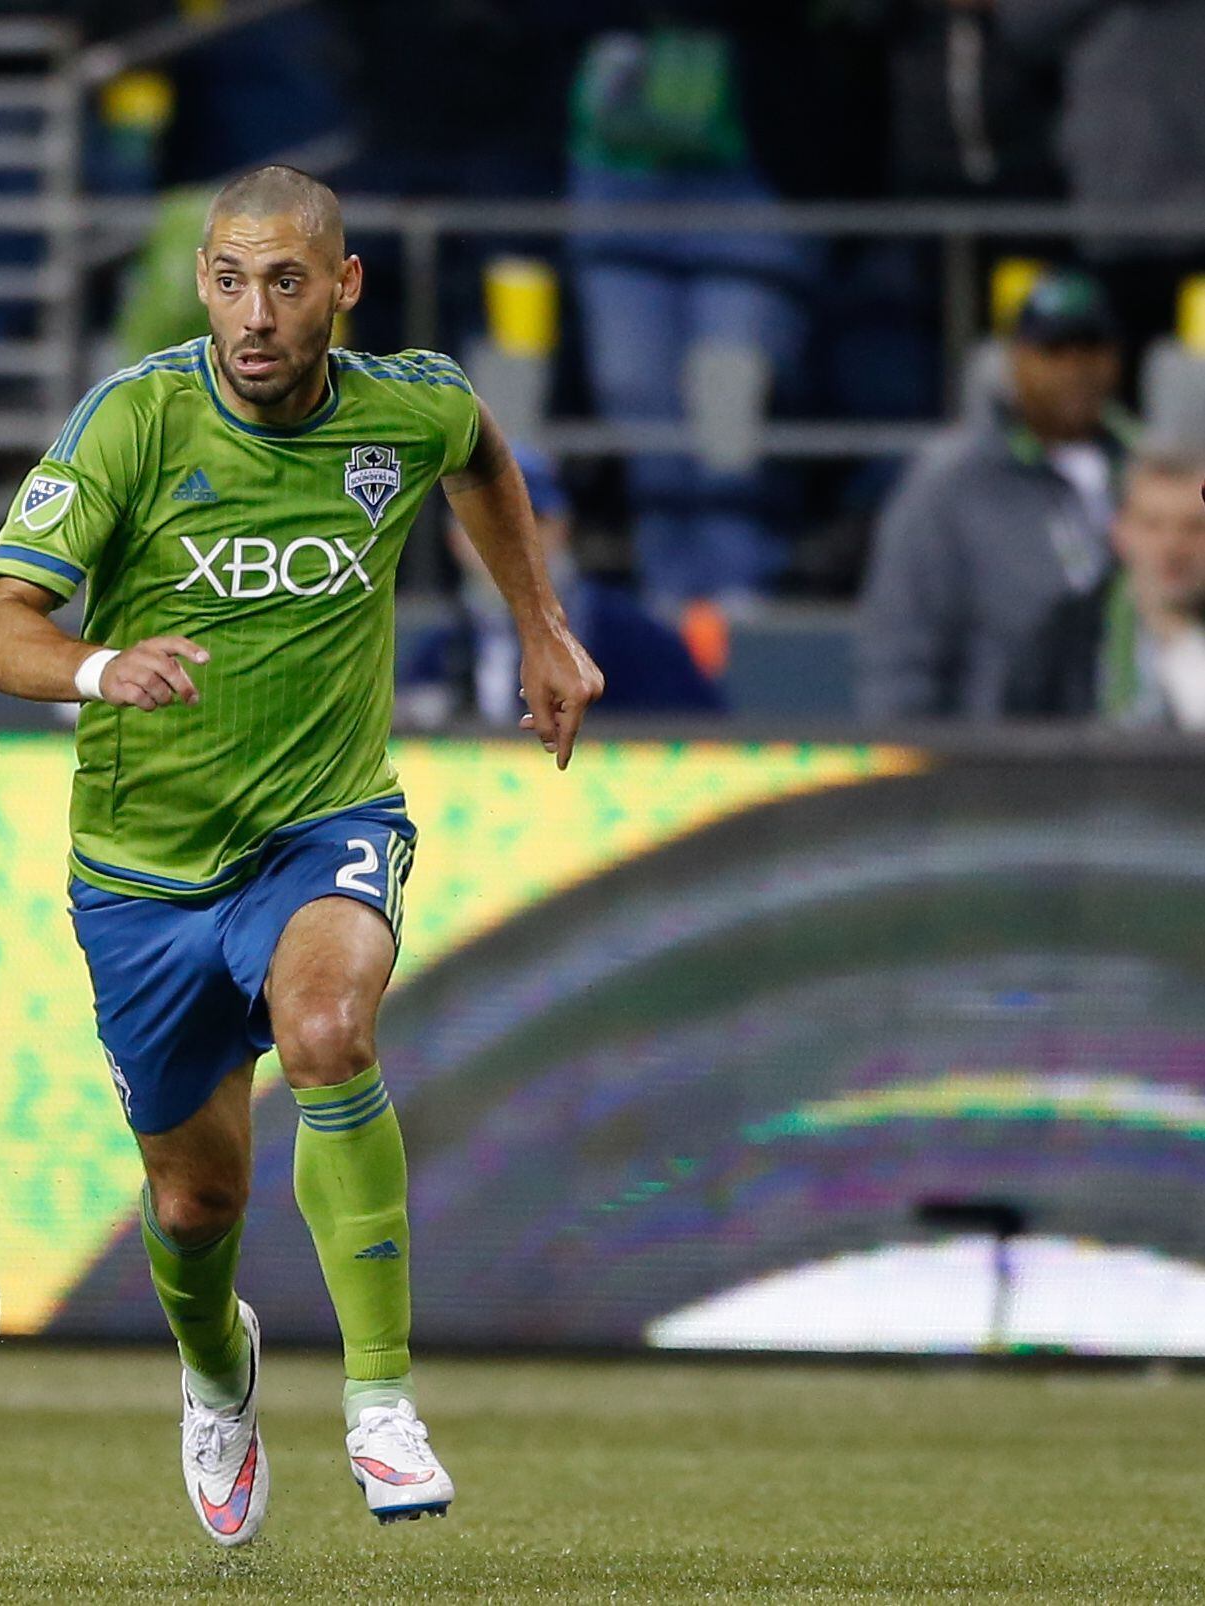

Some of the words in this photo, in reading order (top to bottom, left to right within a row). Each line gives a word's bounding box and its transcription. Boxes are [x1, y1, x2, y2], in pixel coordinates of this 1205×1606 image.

[350, 473, 386, 485] SOUNDERS
[32, 480, 57, 495] MLS
[172, 488, 219, 502] adidas
[175, 535, 379, 599] XBOX
[335, 839, 382, 898] 2
